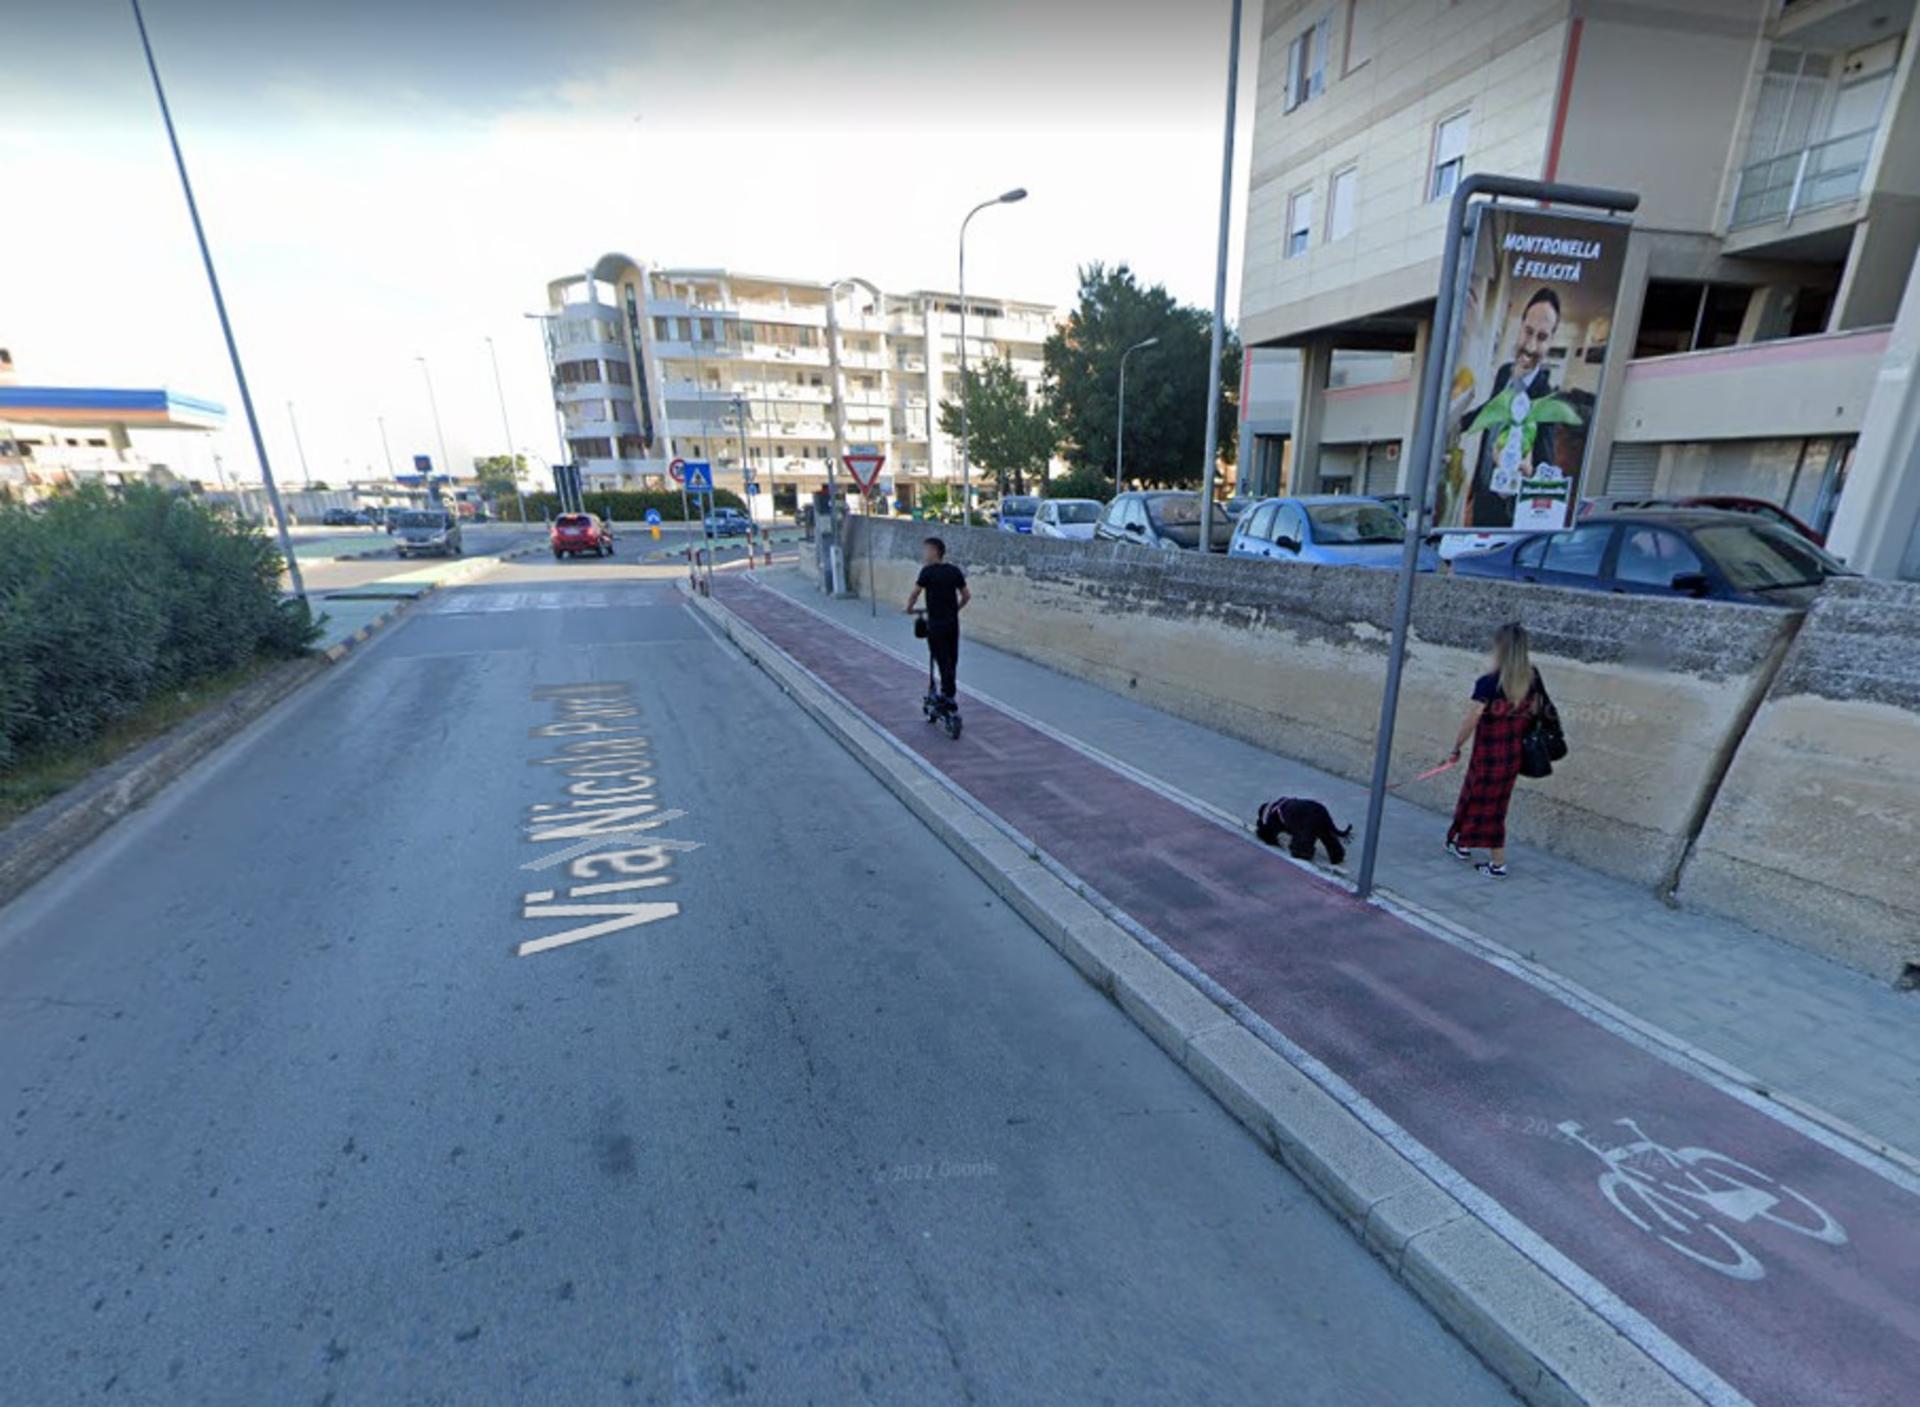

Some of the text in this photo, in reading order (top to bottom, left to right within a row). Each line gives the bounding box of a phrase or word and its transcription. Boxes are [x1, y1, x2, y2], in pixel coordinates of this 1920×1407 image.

[1503, 233, 1601, 260] MONTRONELLA
[1512, 255, 1581, 282] È FELICITÀ
